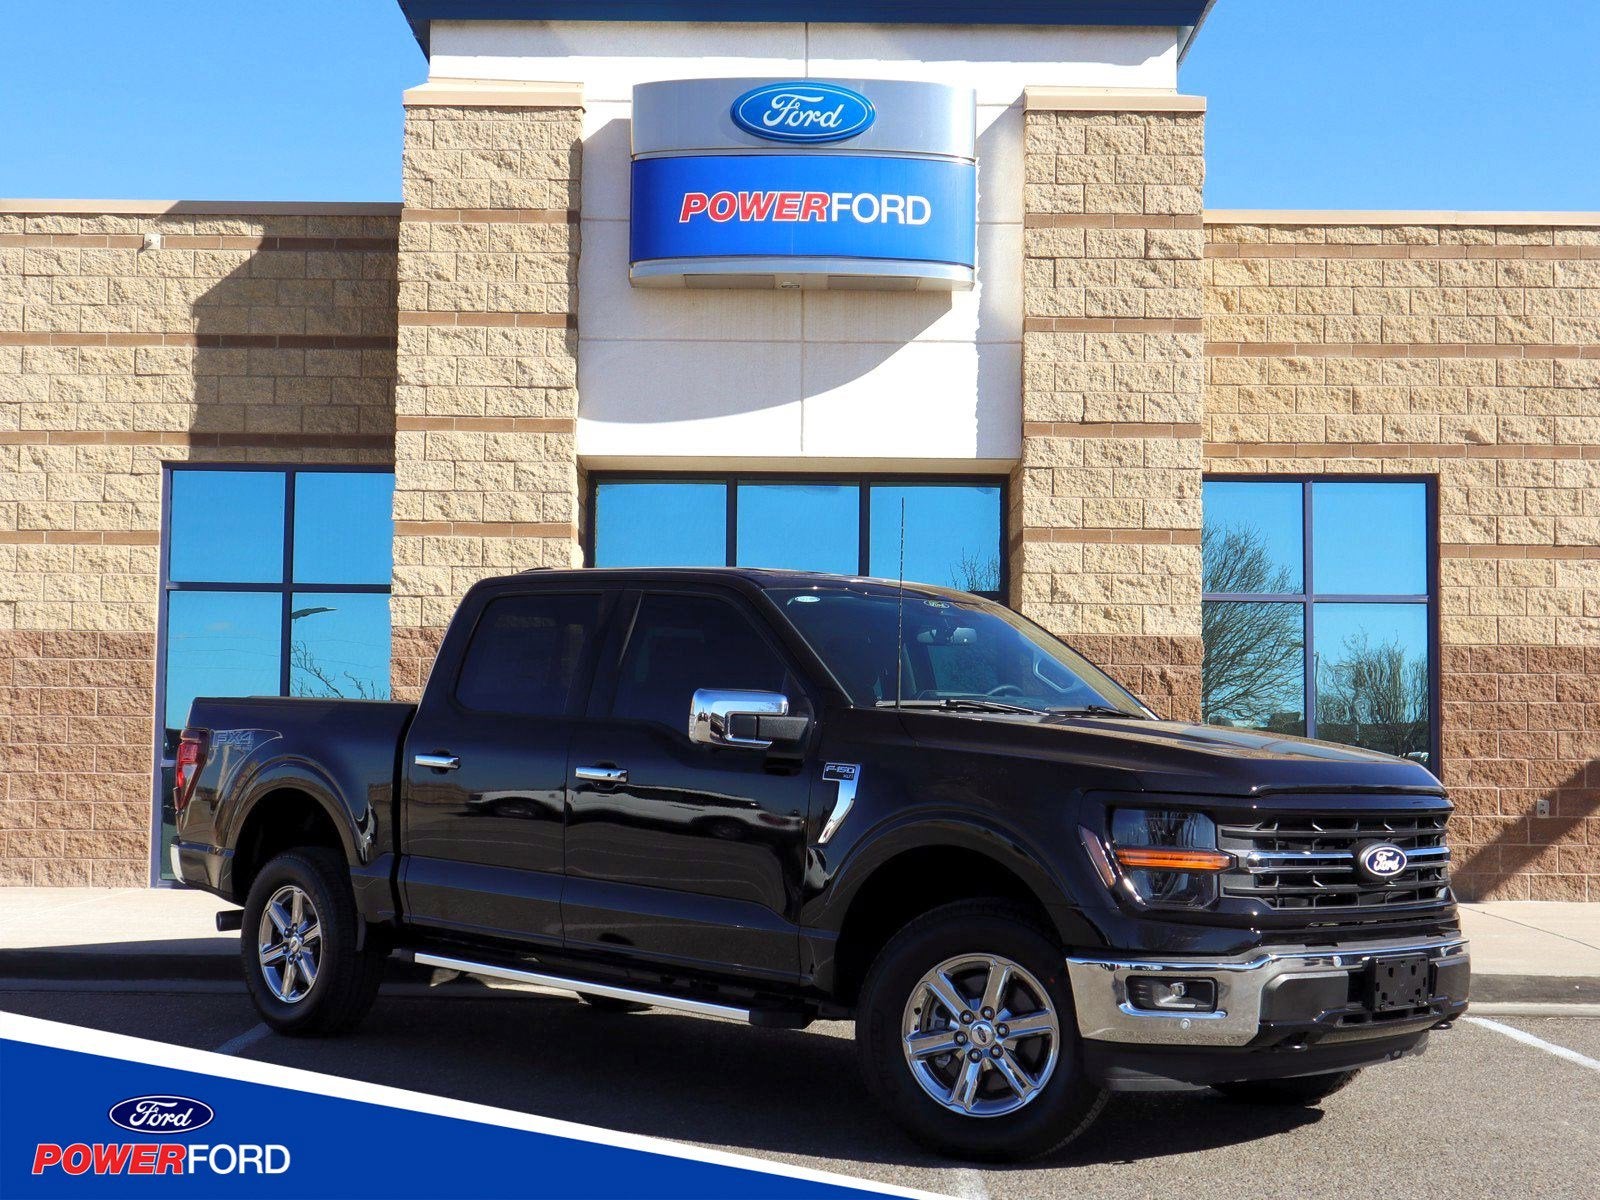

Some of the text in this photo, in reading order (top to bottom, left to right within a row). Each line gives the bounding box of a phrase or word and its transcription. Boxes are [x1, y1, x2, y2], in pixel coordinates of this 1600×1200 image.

[763, 93, 844, 128] Ford
[212, 730, 254, 748] FX4
[825, 765, 855, 774] F-150
[1373, 851, 1400, 871] Ford
